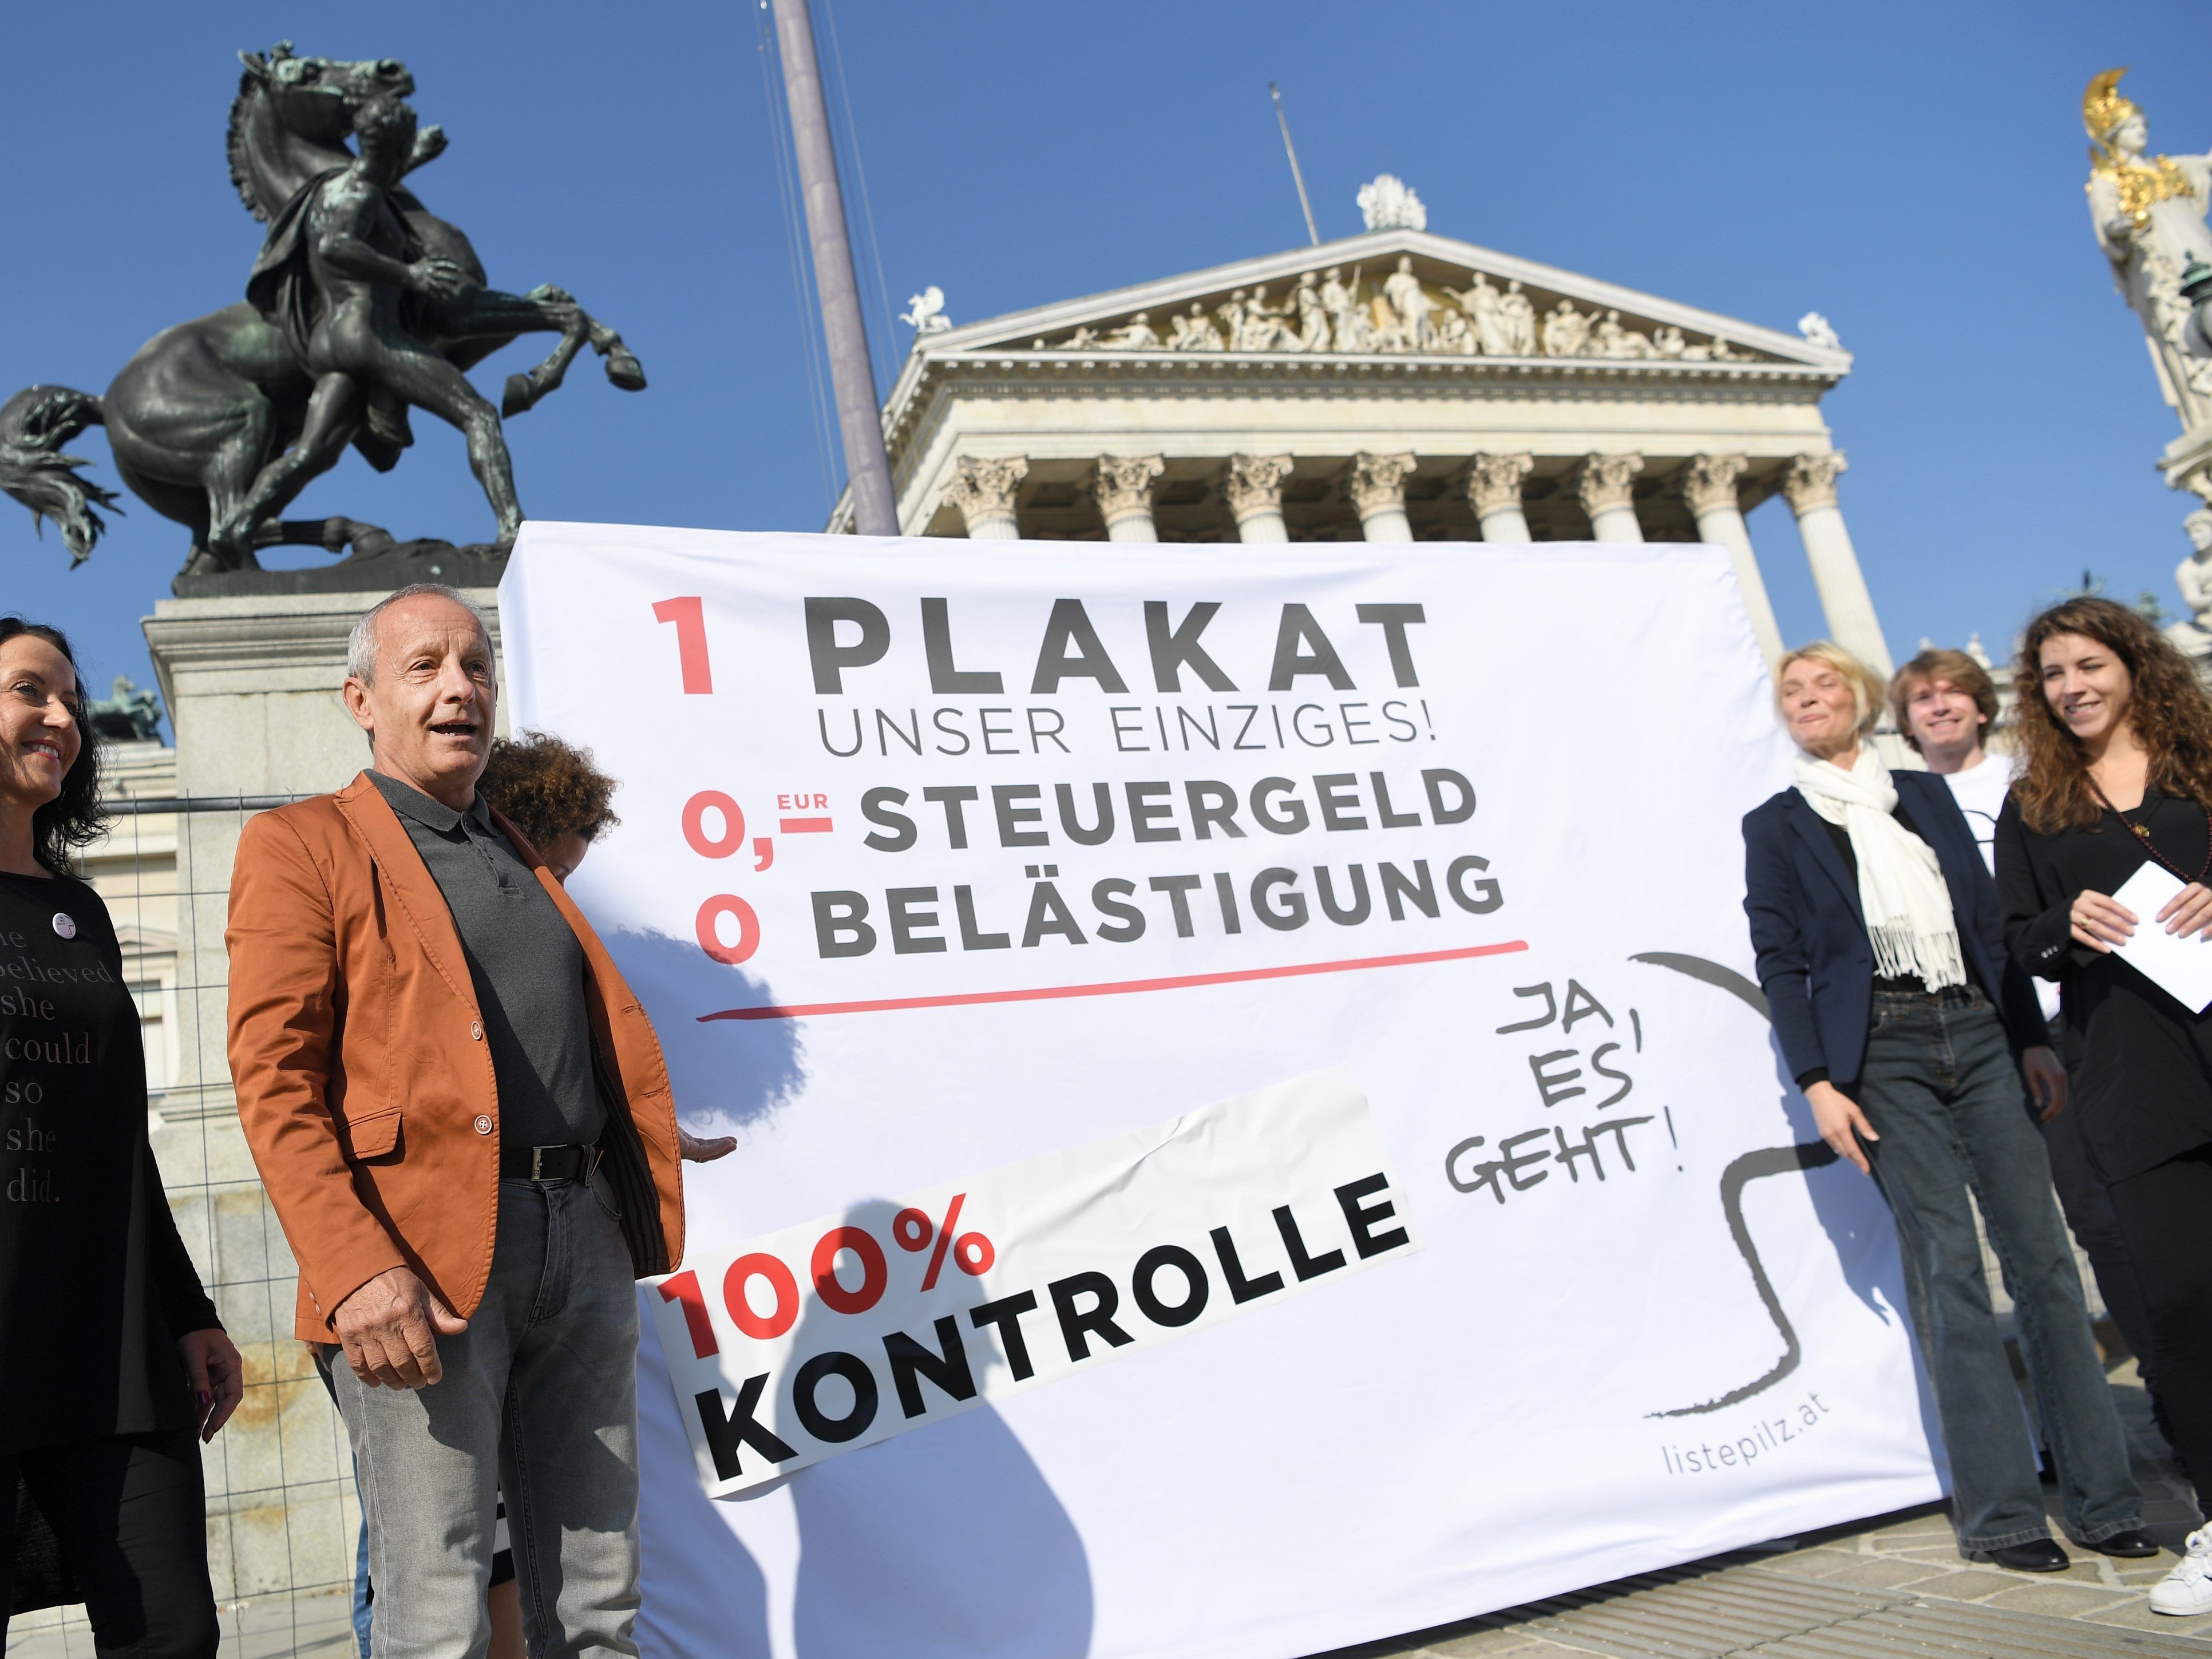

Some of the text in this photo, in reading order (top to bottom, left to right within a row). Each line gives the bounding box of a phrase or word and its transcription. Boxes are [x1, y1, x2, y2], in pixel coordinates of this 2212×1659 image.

[651, 596, 1426, 695] 1 PLAKAT
[818, 699, 1437, 758] UNSER EINZIGES!
[777, 793, 829, 810] EUR
[860, 767, 1477, 853] STEUERGELD
[695, 854, 1505, 965] 0 BELÄSTIGUNG
[1, 986, 56, 1020] she
[5, 1032, 92, 1064] could
[1529, 1042, 1633, 1110] ES
[5, 1080, 43, 1104] so
[6, 1118, 56, 1152] she
[6, 1167, 60, 1202] did.
[657, 1193, 995, 1360] 100%
[694, 1171, 1410, 1482] KONTROLLE
[1662, 1391, 1830, 1475] listepilz.at
